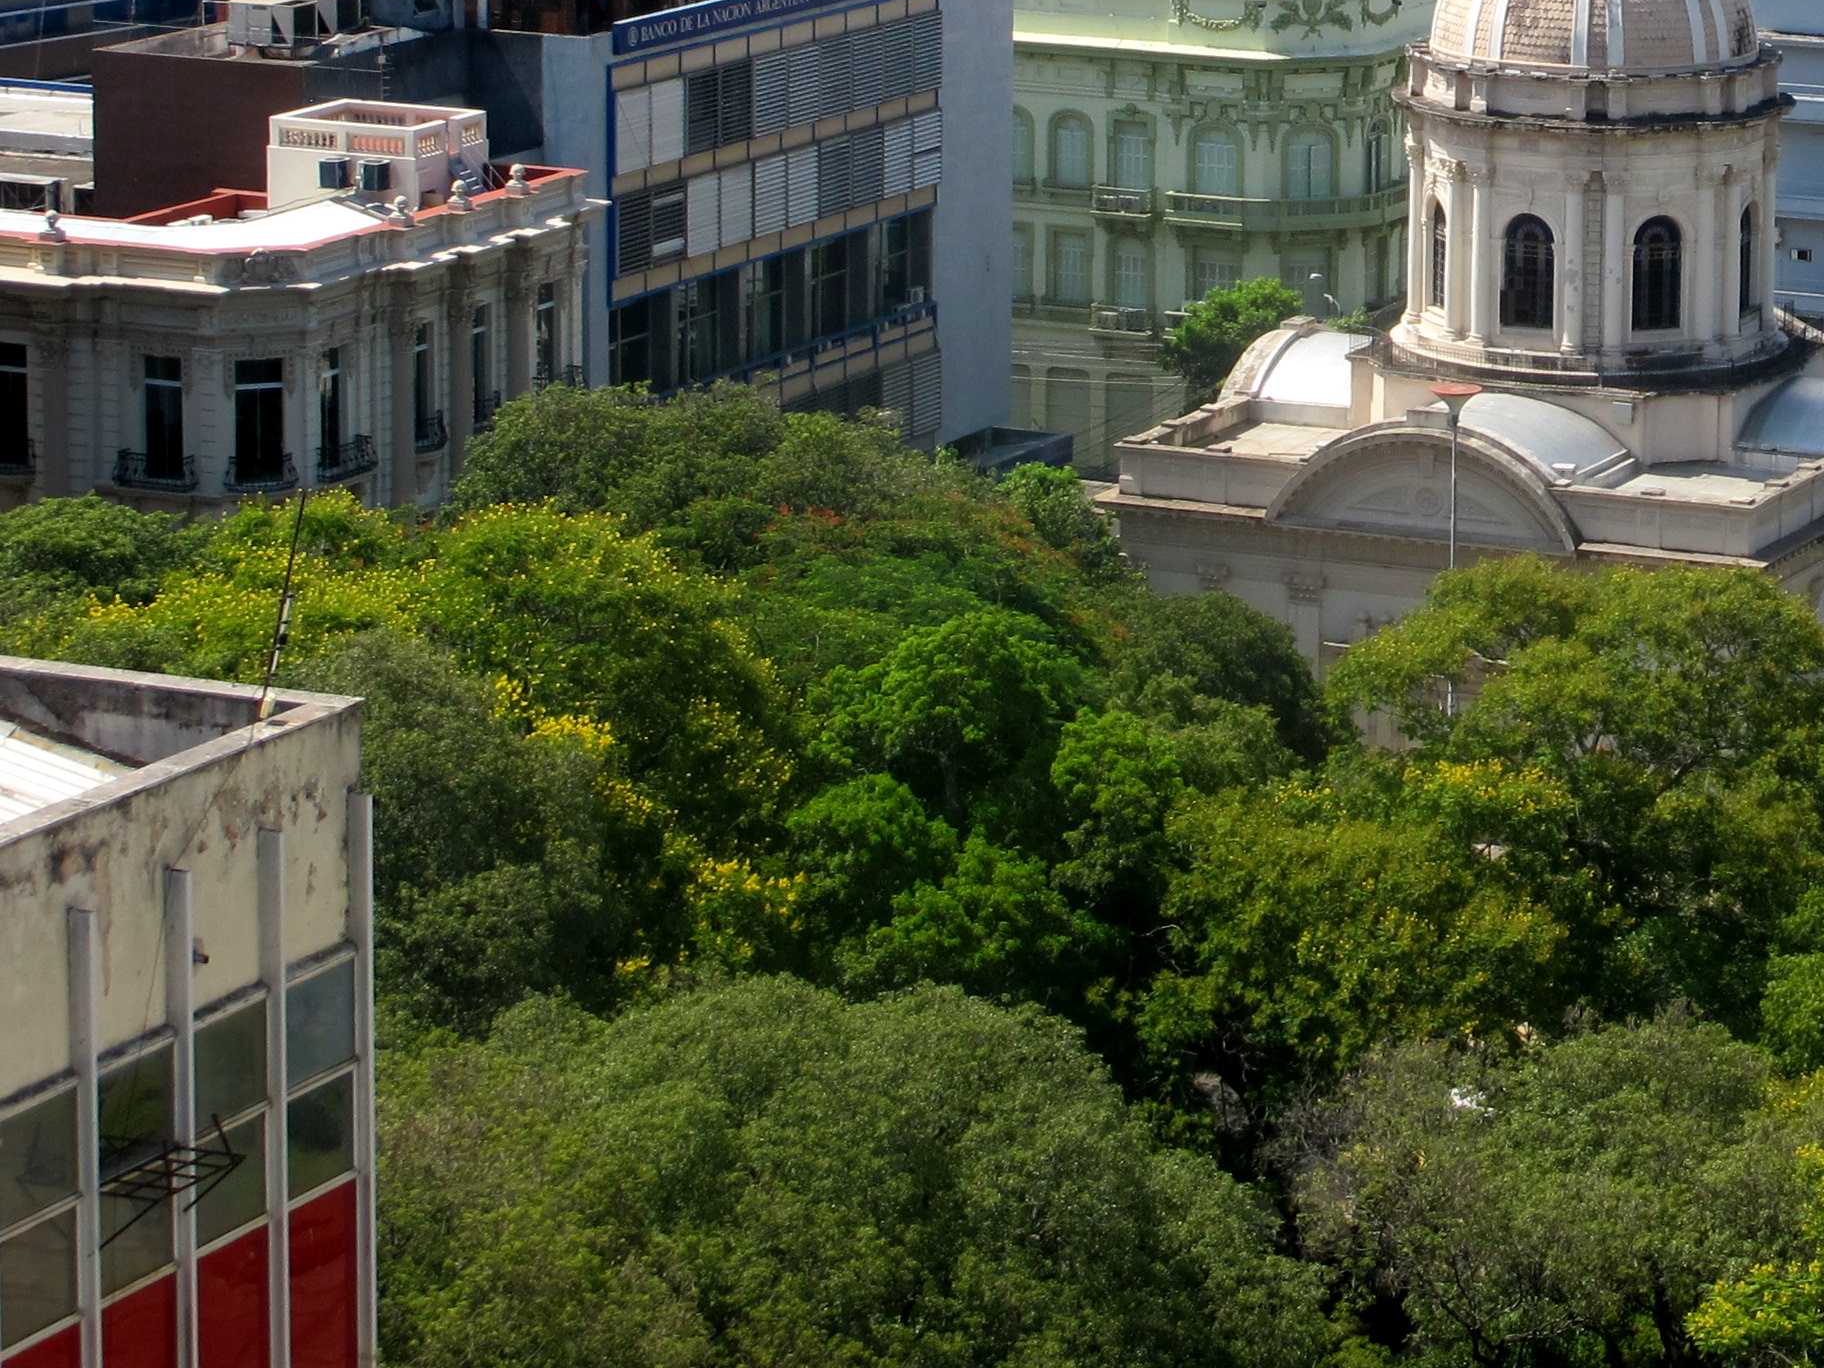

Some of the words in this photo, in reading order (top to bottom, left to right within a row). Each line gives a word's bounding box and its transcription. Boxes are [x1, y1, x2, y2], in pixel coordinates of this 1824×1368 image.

[641, 19, 678, 42] BANCO
[681, 15, 695, 33] DE
[697, 13, 711, 29] LA
